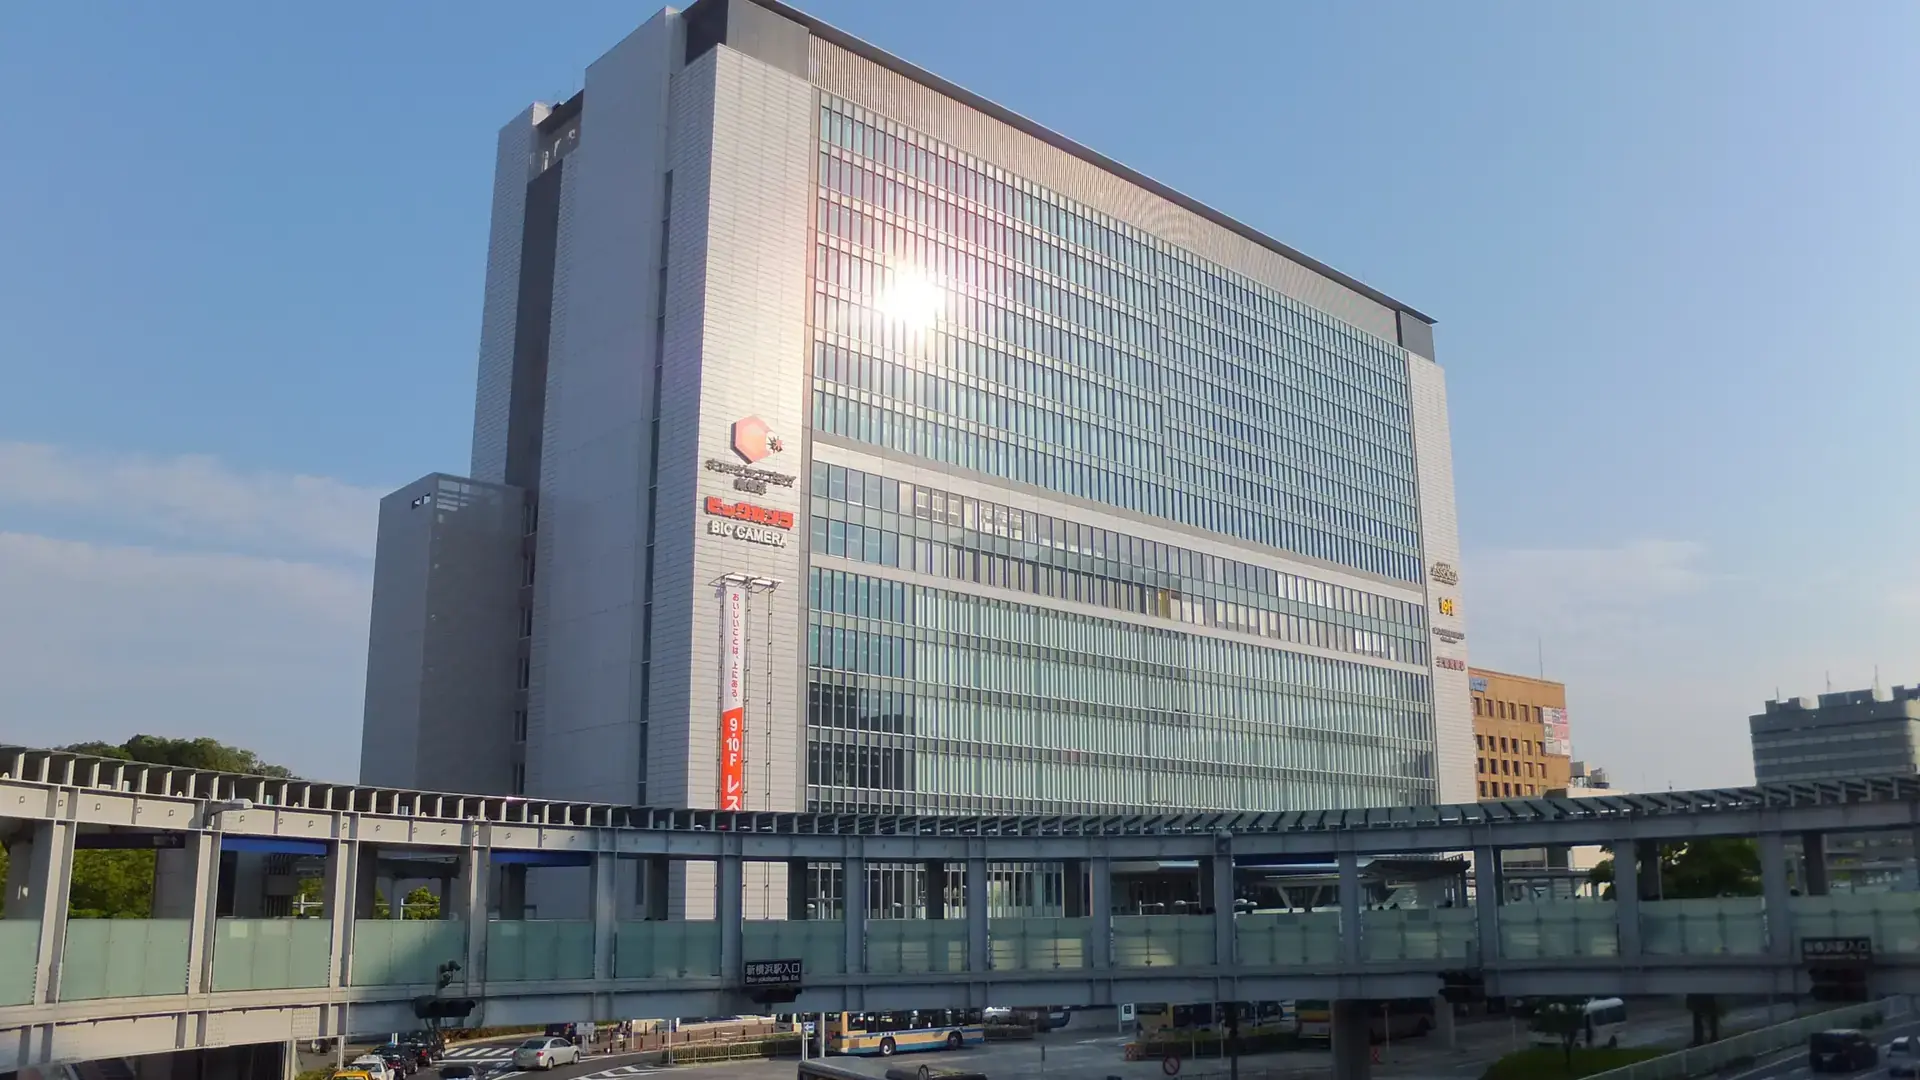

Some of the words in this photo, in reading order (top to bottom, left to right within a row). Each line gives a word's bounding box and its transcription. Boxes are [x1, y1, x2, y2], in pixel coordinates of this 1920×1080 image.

[710, 520, 733, 536] BIC
[736, 525, 788, 546] CAMERA
[746, 962, 800, 976] 新横浜駅入口
